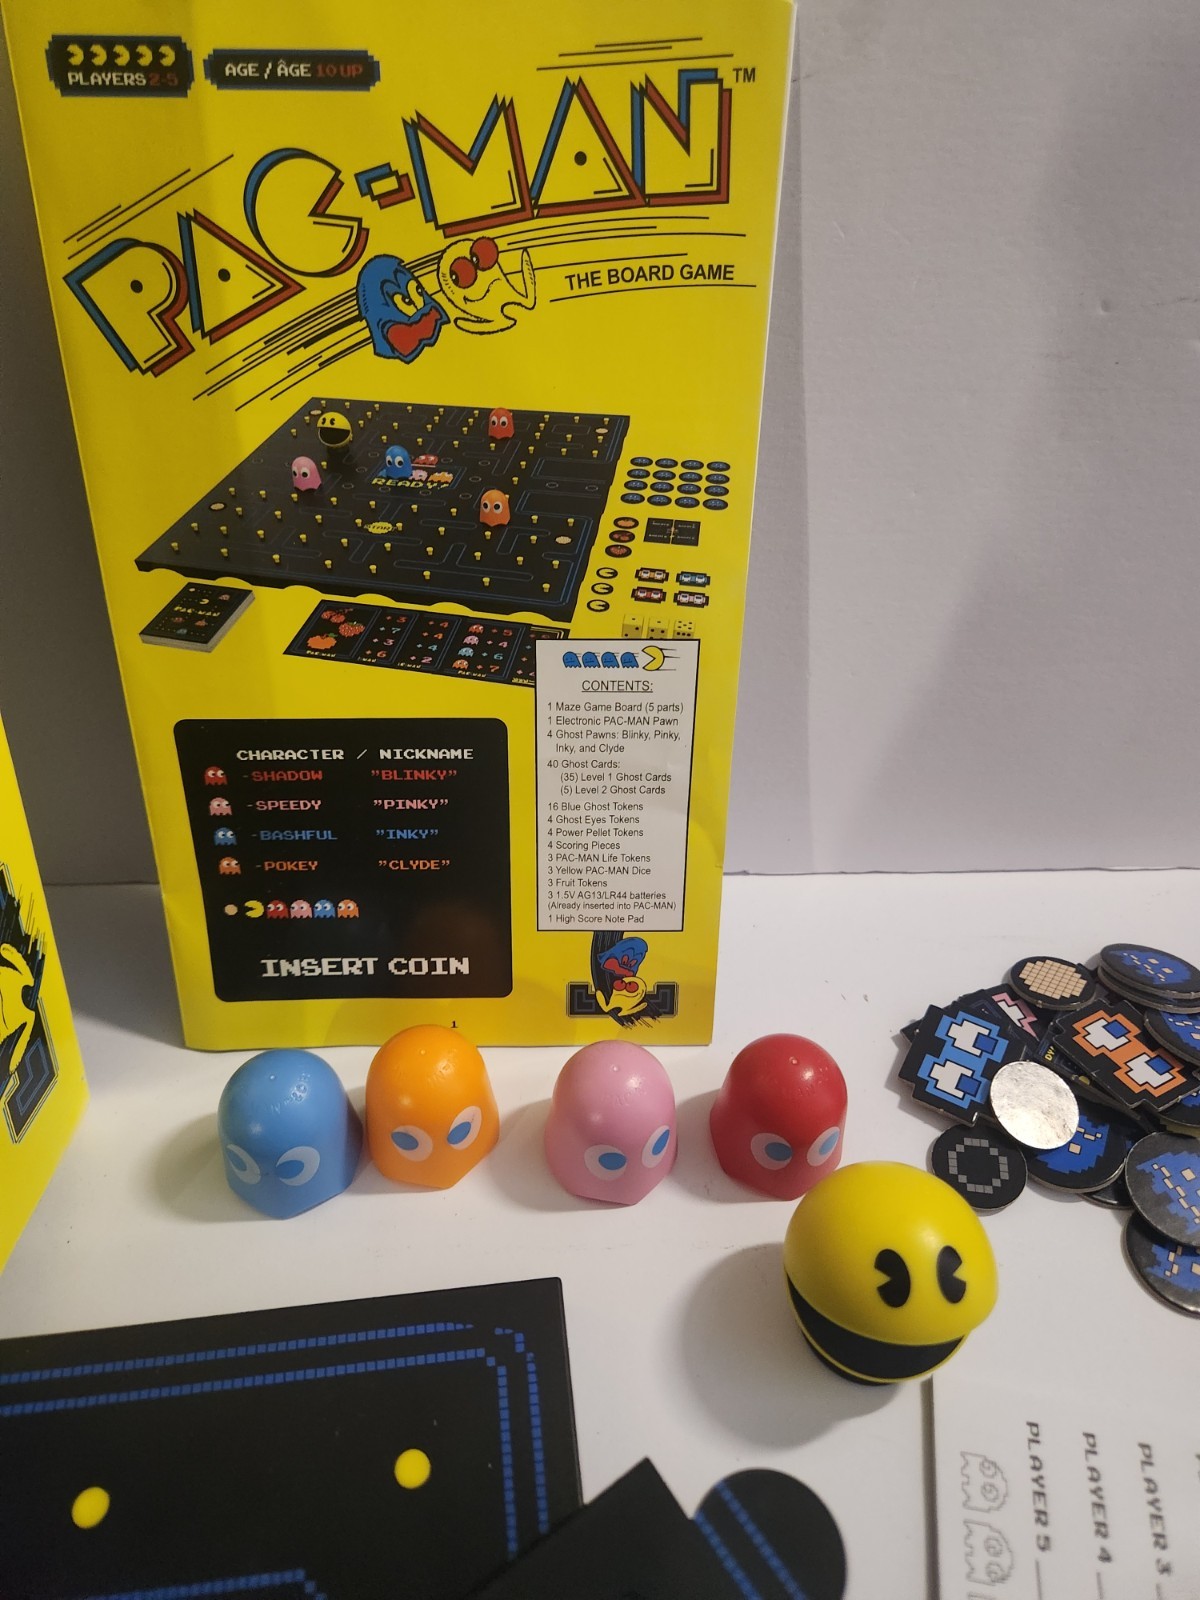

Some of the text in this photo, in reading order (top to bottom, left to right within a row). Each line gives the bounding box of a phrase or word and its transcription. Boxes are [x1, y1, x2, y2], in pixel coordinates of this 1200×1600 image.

[225, 63, 259, 77] AGE
[68, 72, 178, 87] PLAYERS 2-5
[63, 68, 733, 378] PAC-MAN
[565, 264, 735, 290] THE BOARD GAME
[581, 680, 654, 692] CONTENTS:
[548, 702, 684, 715] 1 Maze Game Board (5 parts)
[548, 716, 679, 726] 1 Electronic PAC-MAN Pawn
[547, 730, 681, 741] 4 Ghost Pawns: Blinky, Pinky,
[556, 743, 625, 754] Inky, and Clyde
[237, 749, 344, 761] CHARACTER
[380, 748, 474, 760] NICKNAME
[547, 760, 620, 769] 40 Ghost Cards:
[560, 772, 672, 783] (35) Level 1 Ghost Cards
[560, 785, 666, 796] (5) Level 2 Ghost Cards
[548, 802, 644, 811] 16 Blue Ghost Tokens
[547, 815, 640, 826] 4 Ghost Eyes Tokens
[547, 828, 644, 837] 4 Power Pellet Tokens
[547, 841, 621, 852] 4 Scoring Pieces
[548, 853, 651, 863] 3 PAC-MAN Life Tokens
[548, 866, 651, 875] 3 Yellow PAC-MAN Dice
[548, 878, 608, 887] 3 Fruit Tokens
[548, 891, 666, 899] 3 1.5V AG13/LR44 batteries
[548, 902, 676, 911] (Already inserted into PAC-MAN)
[549, 914, 645, 925] 1 High Score Note Pad
[260, 956, 470, 978] INSERT COIN
[1026, 1421, 1052, 1553] PLAYER 5
[1082, 1431, 1113, 1563] PLAYER 4
[1138, 1442, 1172, 1576] PLAYER 3
